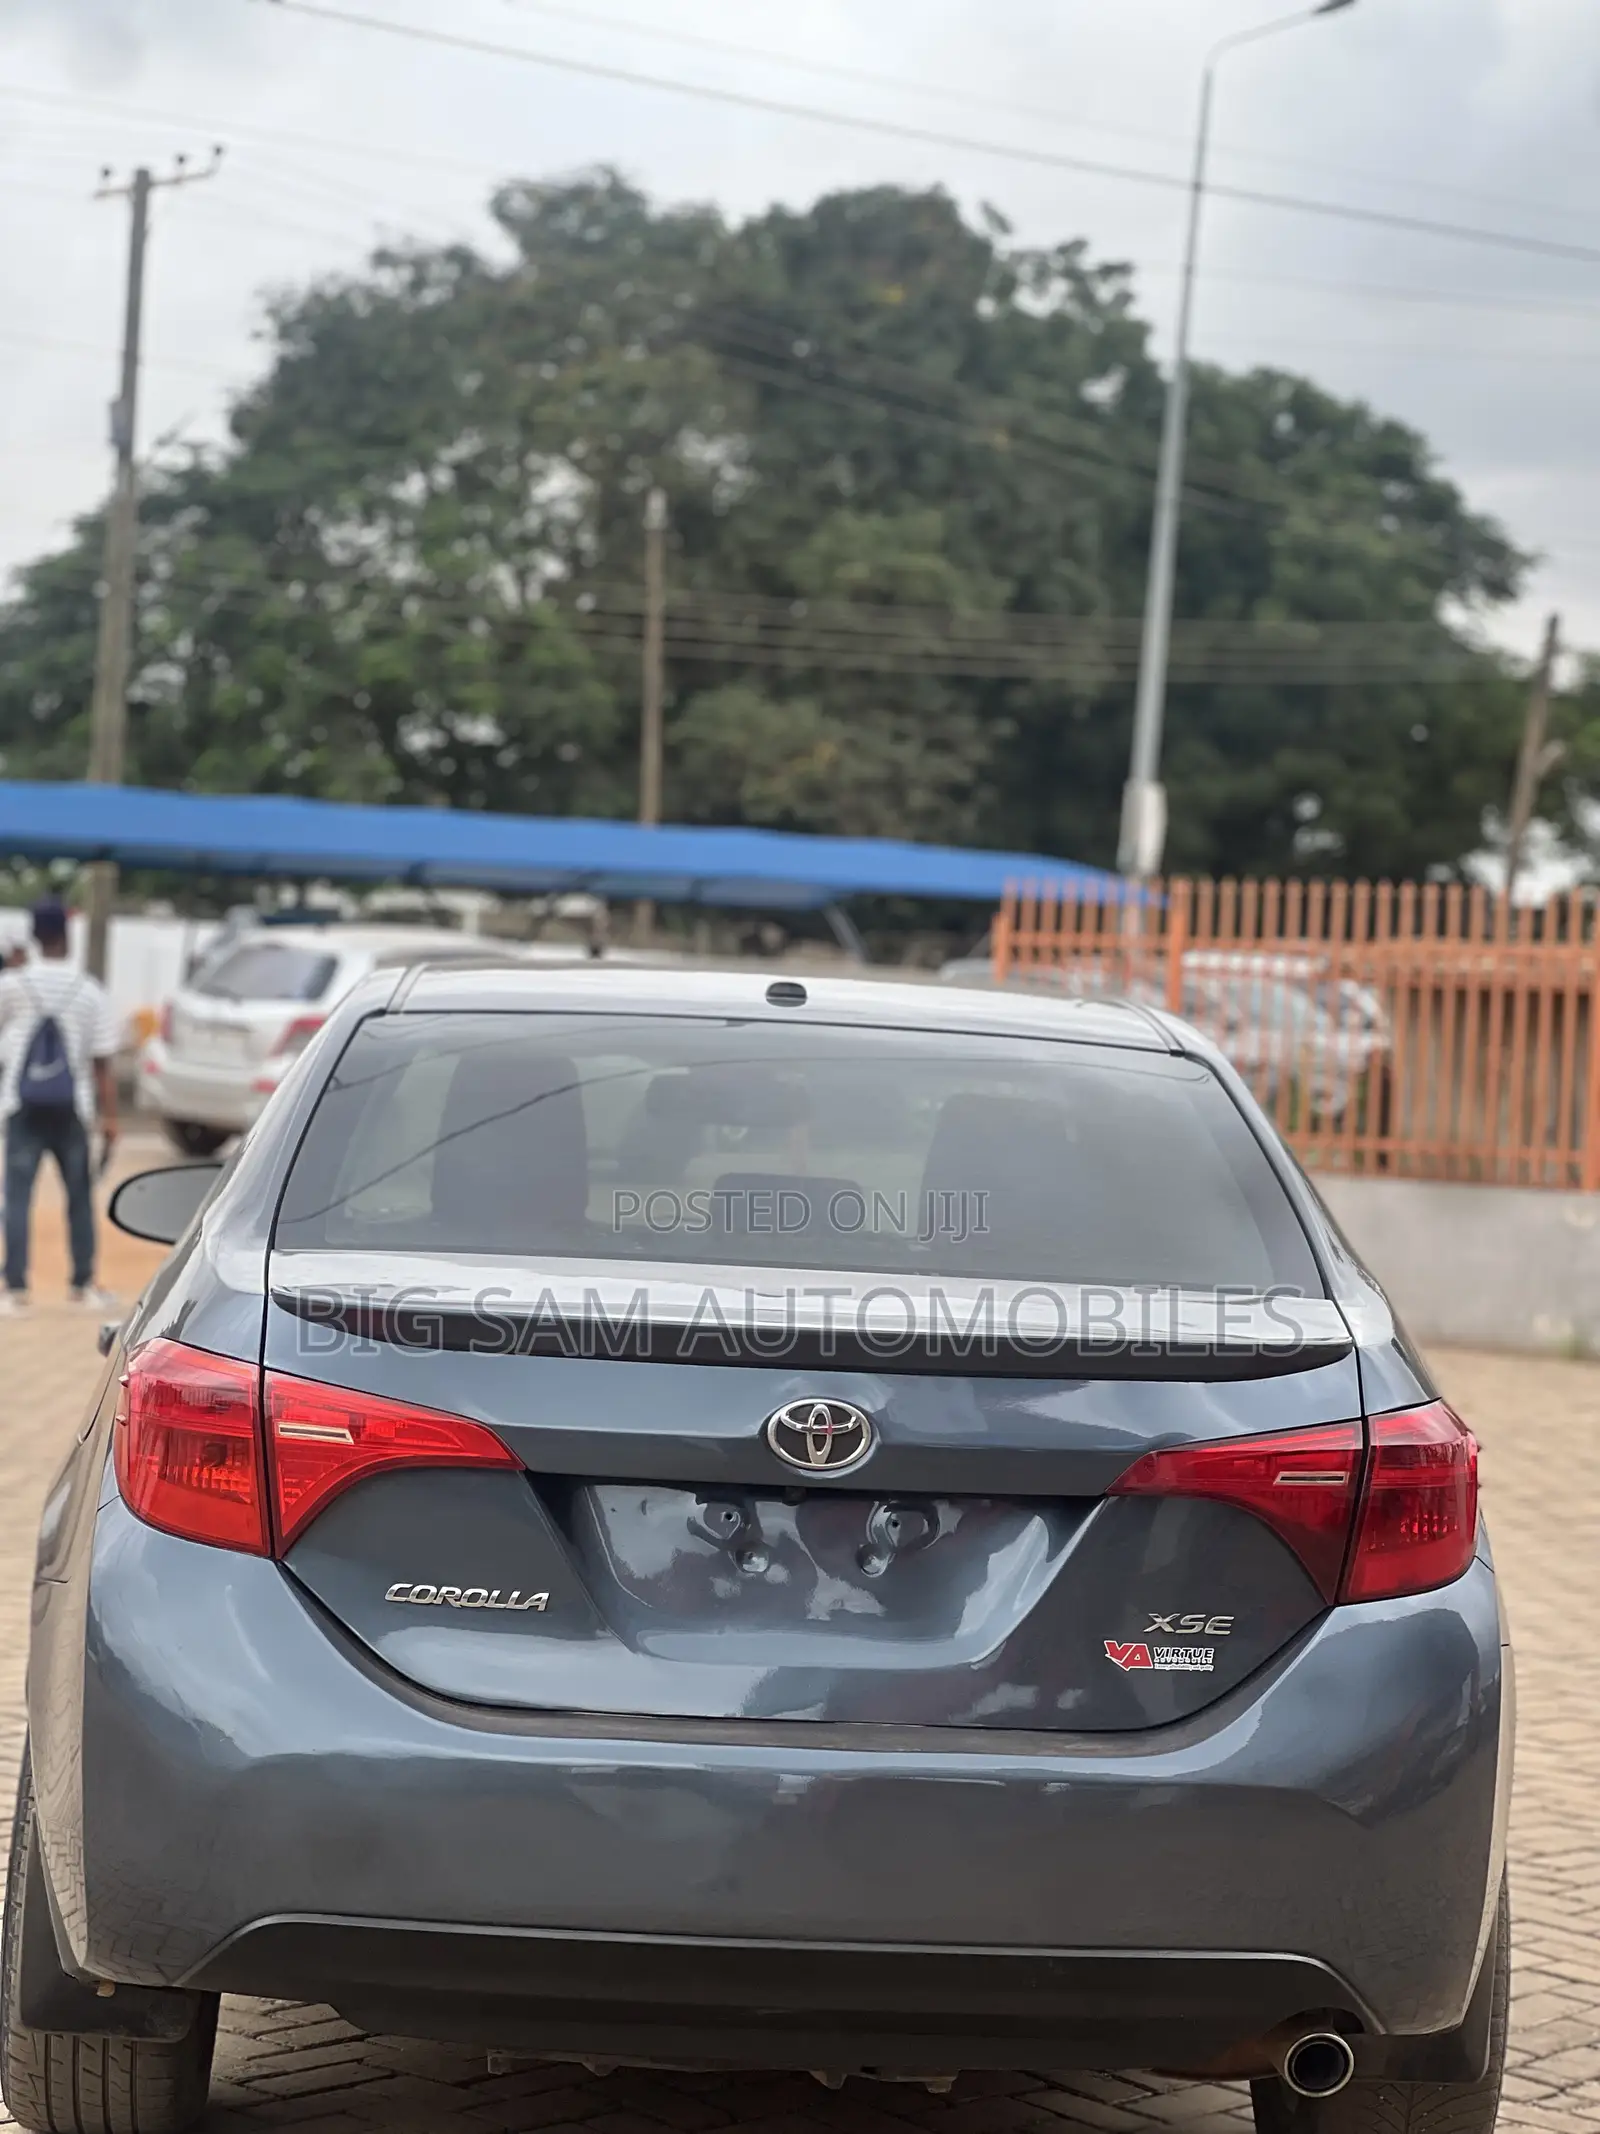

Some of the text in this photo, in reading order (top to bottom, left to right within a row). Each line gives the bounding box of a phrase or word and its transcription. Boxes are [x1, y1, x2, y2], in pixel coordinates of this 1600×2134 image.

[385, 1583, 550, 1612] COROLLA
[1143, 1613, 1235, 1636] XSE
[1153, 1647, 1214, 1659] VIRTUE
